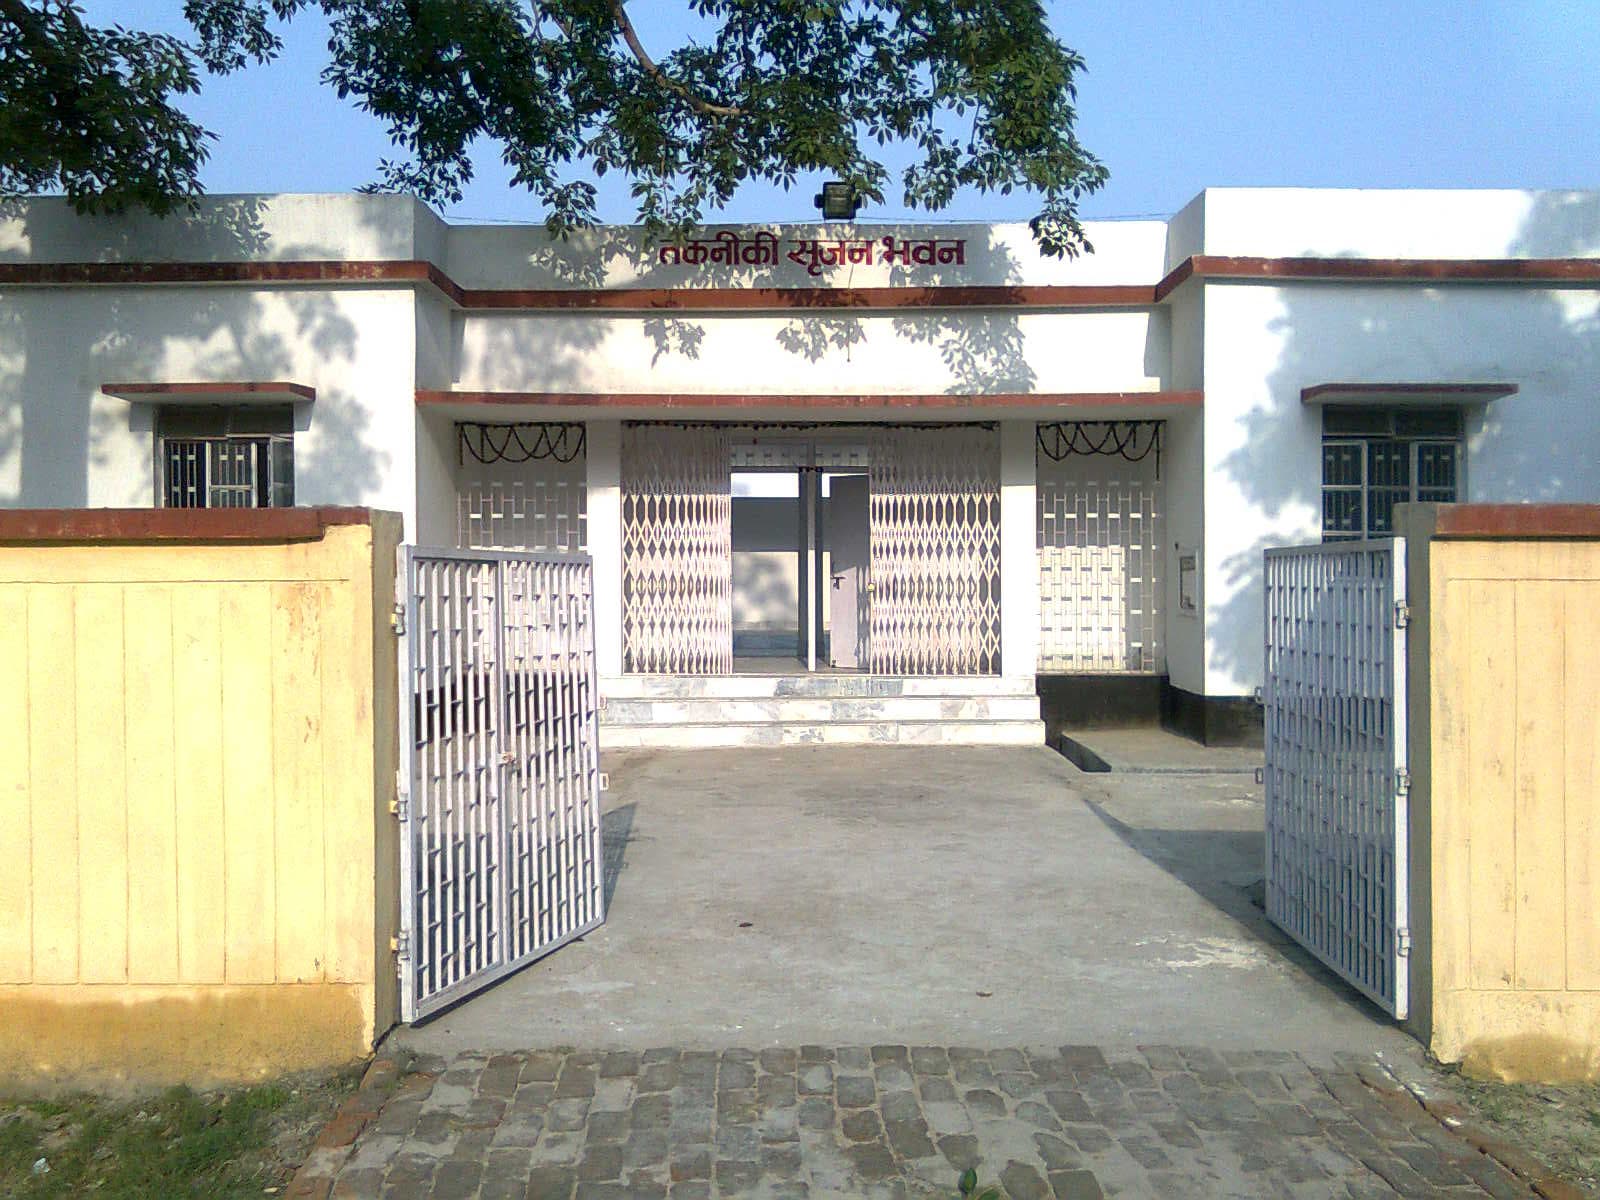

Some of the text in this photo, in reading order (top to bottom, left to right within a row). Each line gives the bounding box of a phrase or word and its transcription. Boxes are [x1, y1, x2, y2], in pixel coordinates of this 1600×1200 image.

[659, 231, 967, 276] तकनीकी सृजन भवन
